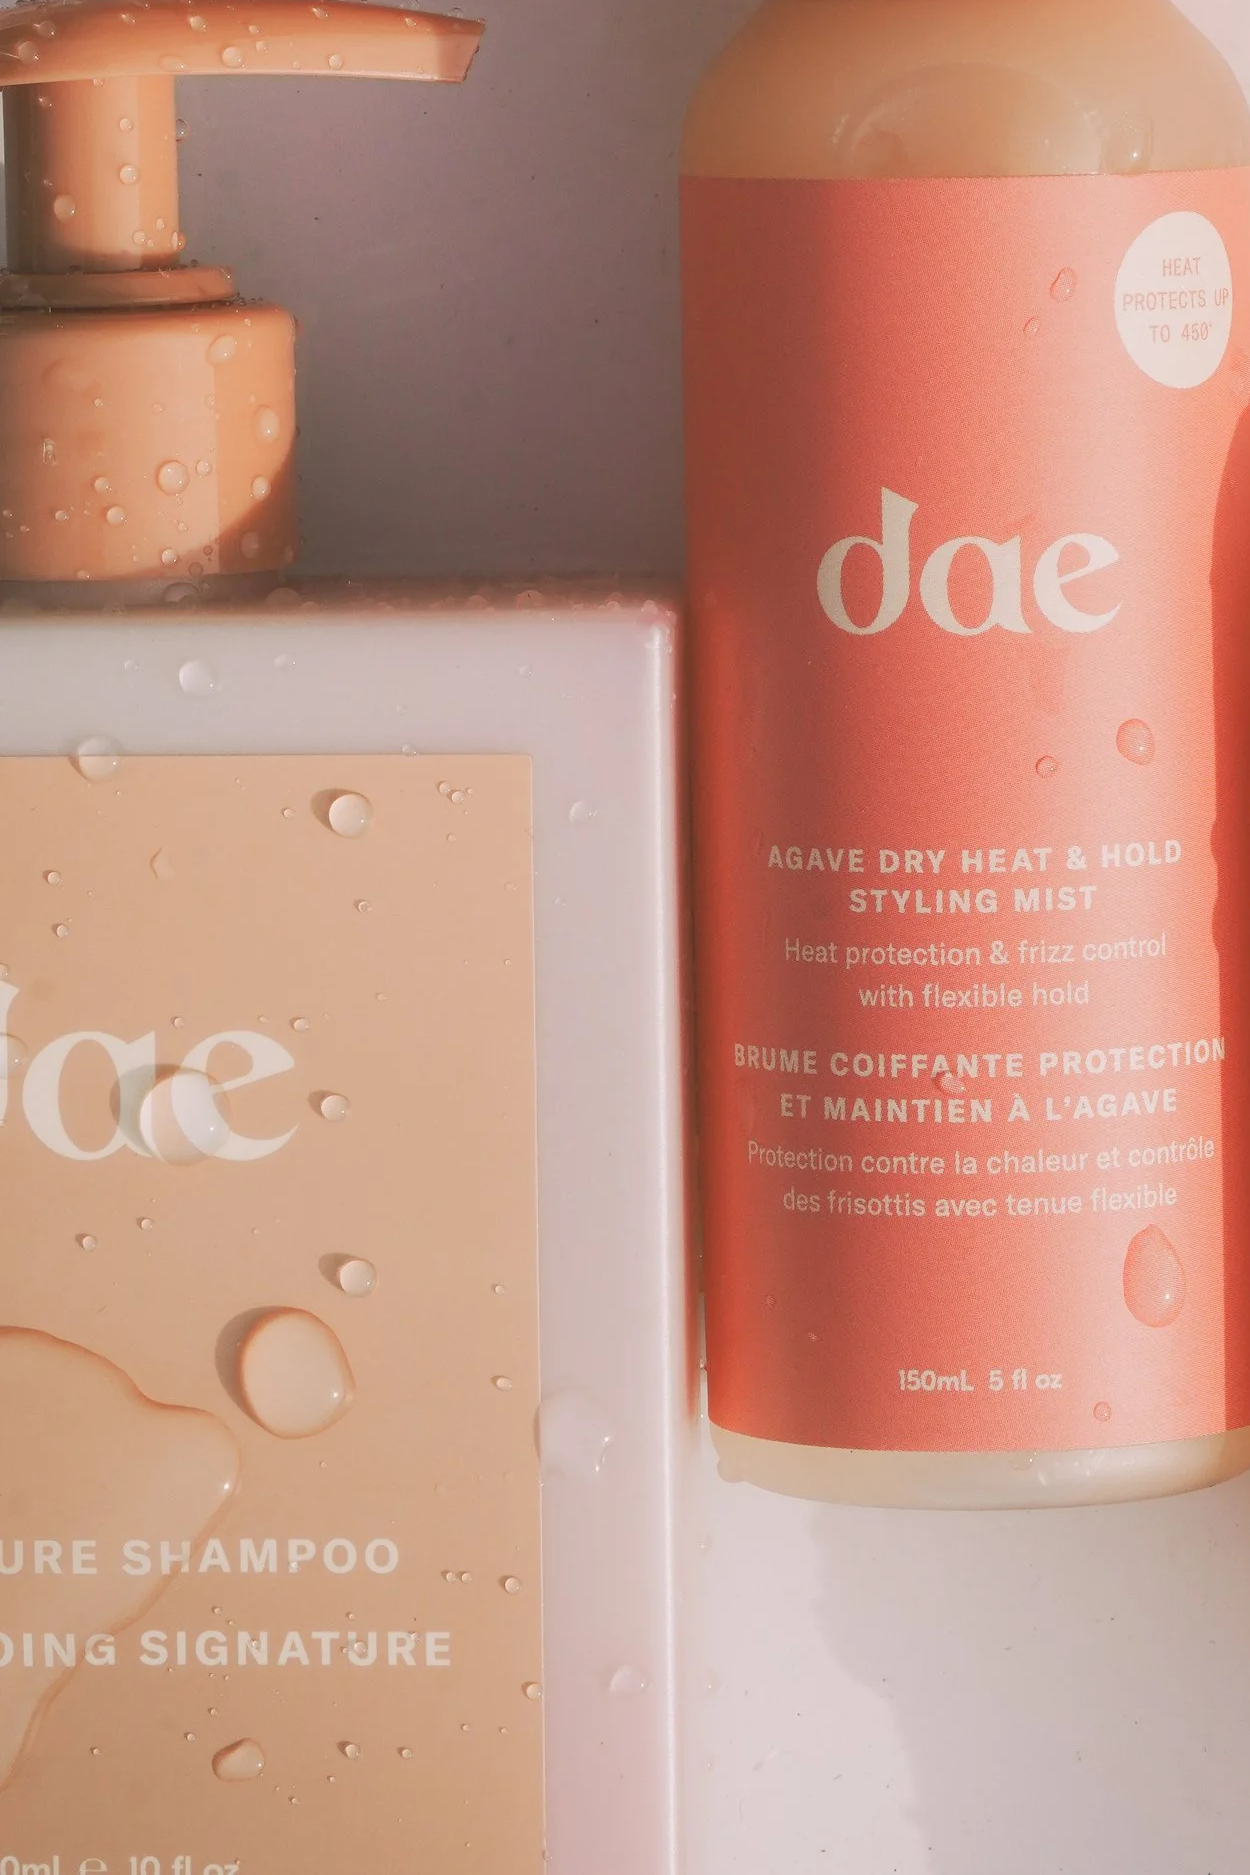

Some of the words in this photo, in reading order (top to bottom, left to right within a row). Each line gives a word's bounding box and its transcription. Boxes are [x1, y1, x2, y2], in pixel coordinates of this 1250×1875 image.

[1162, 257, 1201, 277] HEAT
[1122, 289, 1206, 311] PROTECTS
[1214, 287, 1229, 307] UP
[1150, 325, 1170, 343] TO
[816, 486, 1124, 636] dae
[768, 844, 864, 873] AGAVE
[879, 848, 945, 874] DRY
[961, 847, 1053, 873] HEAT
[1066, 845, 1088, 870] &
[1101, 840, 1182, 869] HOLD
[849, 888, 998, 914] STYLING
[1013, 885, 1097, 912] MIST
[785, 937, 838, 965] Heat
[845, 939, 981, 969] protection
[989, 940, 1009, 965] &
[1018, 939, 1075, 965] frizz
[1083, 932, 1167, 961] control
[858, 984, 914, 1008] with
[922, 983, 1023, 1008] flexible
[1033, 980, 1089, 1006] hold
[0, 980, 300, 1161] ae
[734, 1043, 818, 1075] BRUME
[830, 1051, 1024, 1078] COIFFANTE
[1039, 1036, 1226, 1077] PROTECTION
[780, 1093, 811, 1118] ET
[823, 1095, 992, 1124] MAINTIEN
[1007, 1092, 1030, 1123] À
[748, 1140, 852, 1173] Protection
[861, 1150, 944, 1175] contre
[954, 1150, 977, 1175] la
[987, 1147, 1088, 1175] chaleur
[1097, 1145, 1120, 1171] et
[1128, 1135, 1215, 1168] contrôle
[783, 1186, 820, 1213] des
[827, 1189, 925, 1217] frisottis
[935, 1195, 997, 1217] avec
[1006, 1192, 1082, 1216] tenue
[1091, 1183, 1177, 1213] flexible
[898, 1368, 975, 1392] 150mL
[989, 1368, 1004, 1391] 5
[1012, 1368, 1027, 1390] fl
[1035, 1373, 1063, 1390] oz
[122, 1538, 400, 1576] SHAMPOO
[140, 1630, 452, 1666] SIGNATURE
